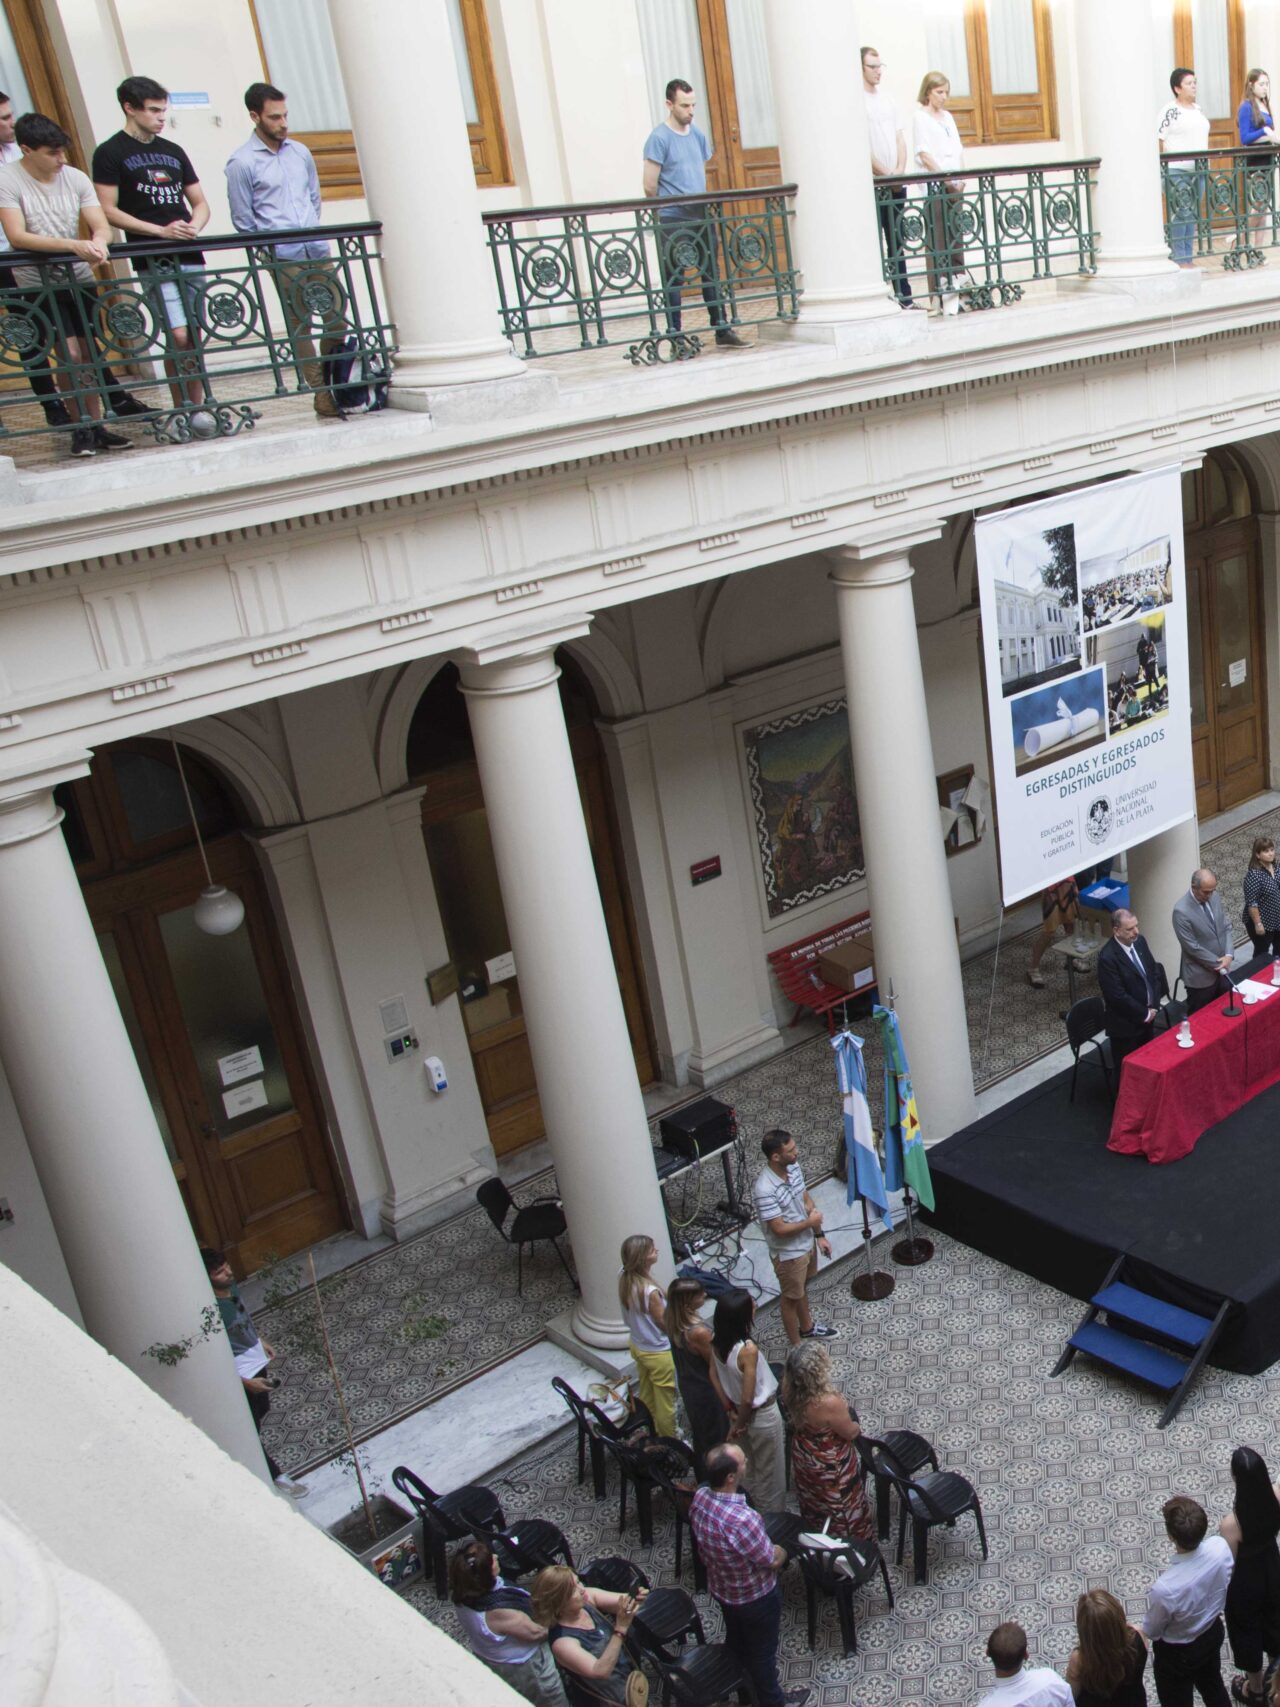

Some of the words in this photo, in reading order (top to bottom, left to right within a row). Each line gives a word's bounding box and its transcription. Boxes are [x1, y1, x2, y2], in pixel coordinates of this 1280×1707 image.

[124, 153, 182, 171] HOLLISTER
[151, 195, 180, 205] 1922
[1026, 760, 1090, 797] EGRESADAS
[1092, 756, 1099, 767] Y
[1102, 728, 1165, 765] EGRESADOS
[1060, 755, 1137, 798] DISTINGUIDOS
[1115, 780, 1157, 806] UNIVERSIDAD
[1115, 796, 1148, 816] NACIONAL
[1116, 818, 1124, 828] DE
[1126, 813, 1134, 824] LA
[1136, 804, 1154, 821] PLATA
[1040, 818, 1074, 838] EDUCACIÓN
[1047, 840, 1075, 858] GRATUITA
